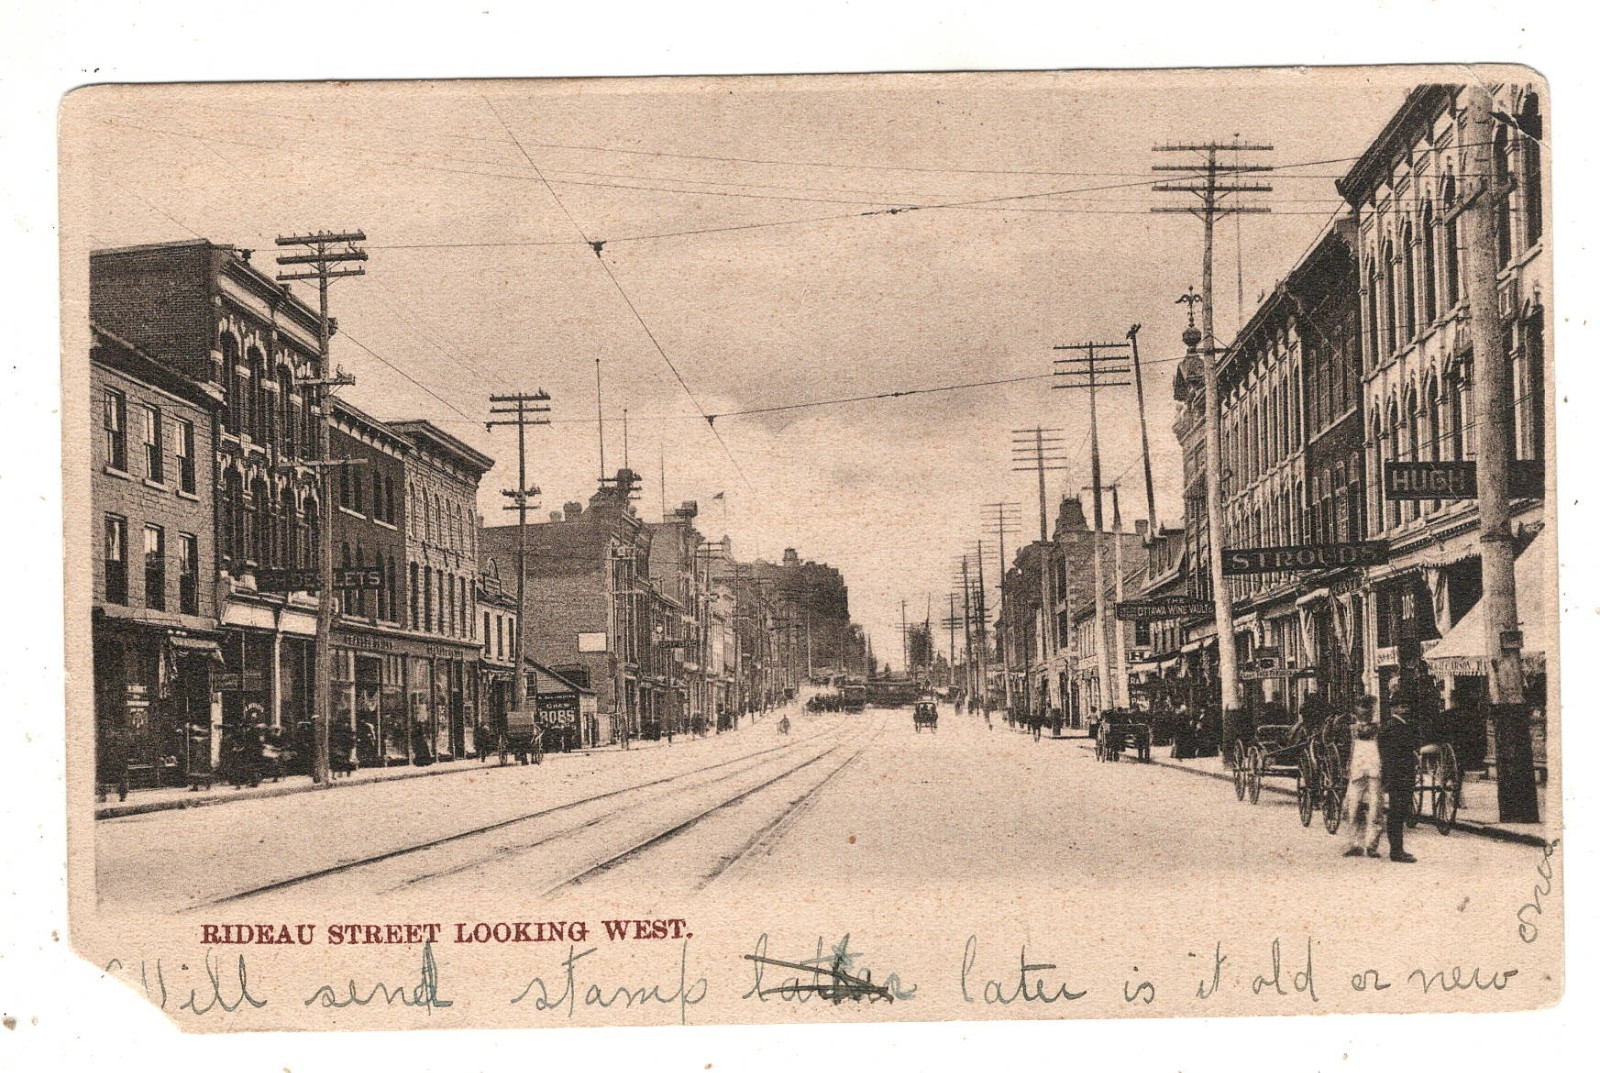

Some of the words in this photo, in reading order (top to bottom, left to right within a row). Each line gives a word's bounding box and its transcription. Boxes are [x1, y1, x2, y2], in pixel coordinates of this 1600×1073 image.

[1393, 470, 1465, 491] HUGH
[1137, 606, 1167, 617] OTTAWA
[1168, 604, 1188, 615] WINE
[510, 939, 709, 1025] stamp
[960, 934, 1088, 1004] later
[1123, 965, 1156, 1004] is
[1187, 940, 1228, 999] it
[1252, 936, 1320, 1001] old
[1351, 968, 1391, 992] or
[1408, 966, 1519, 994] new
